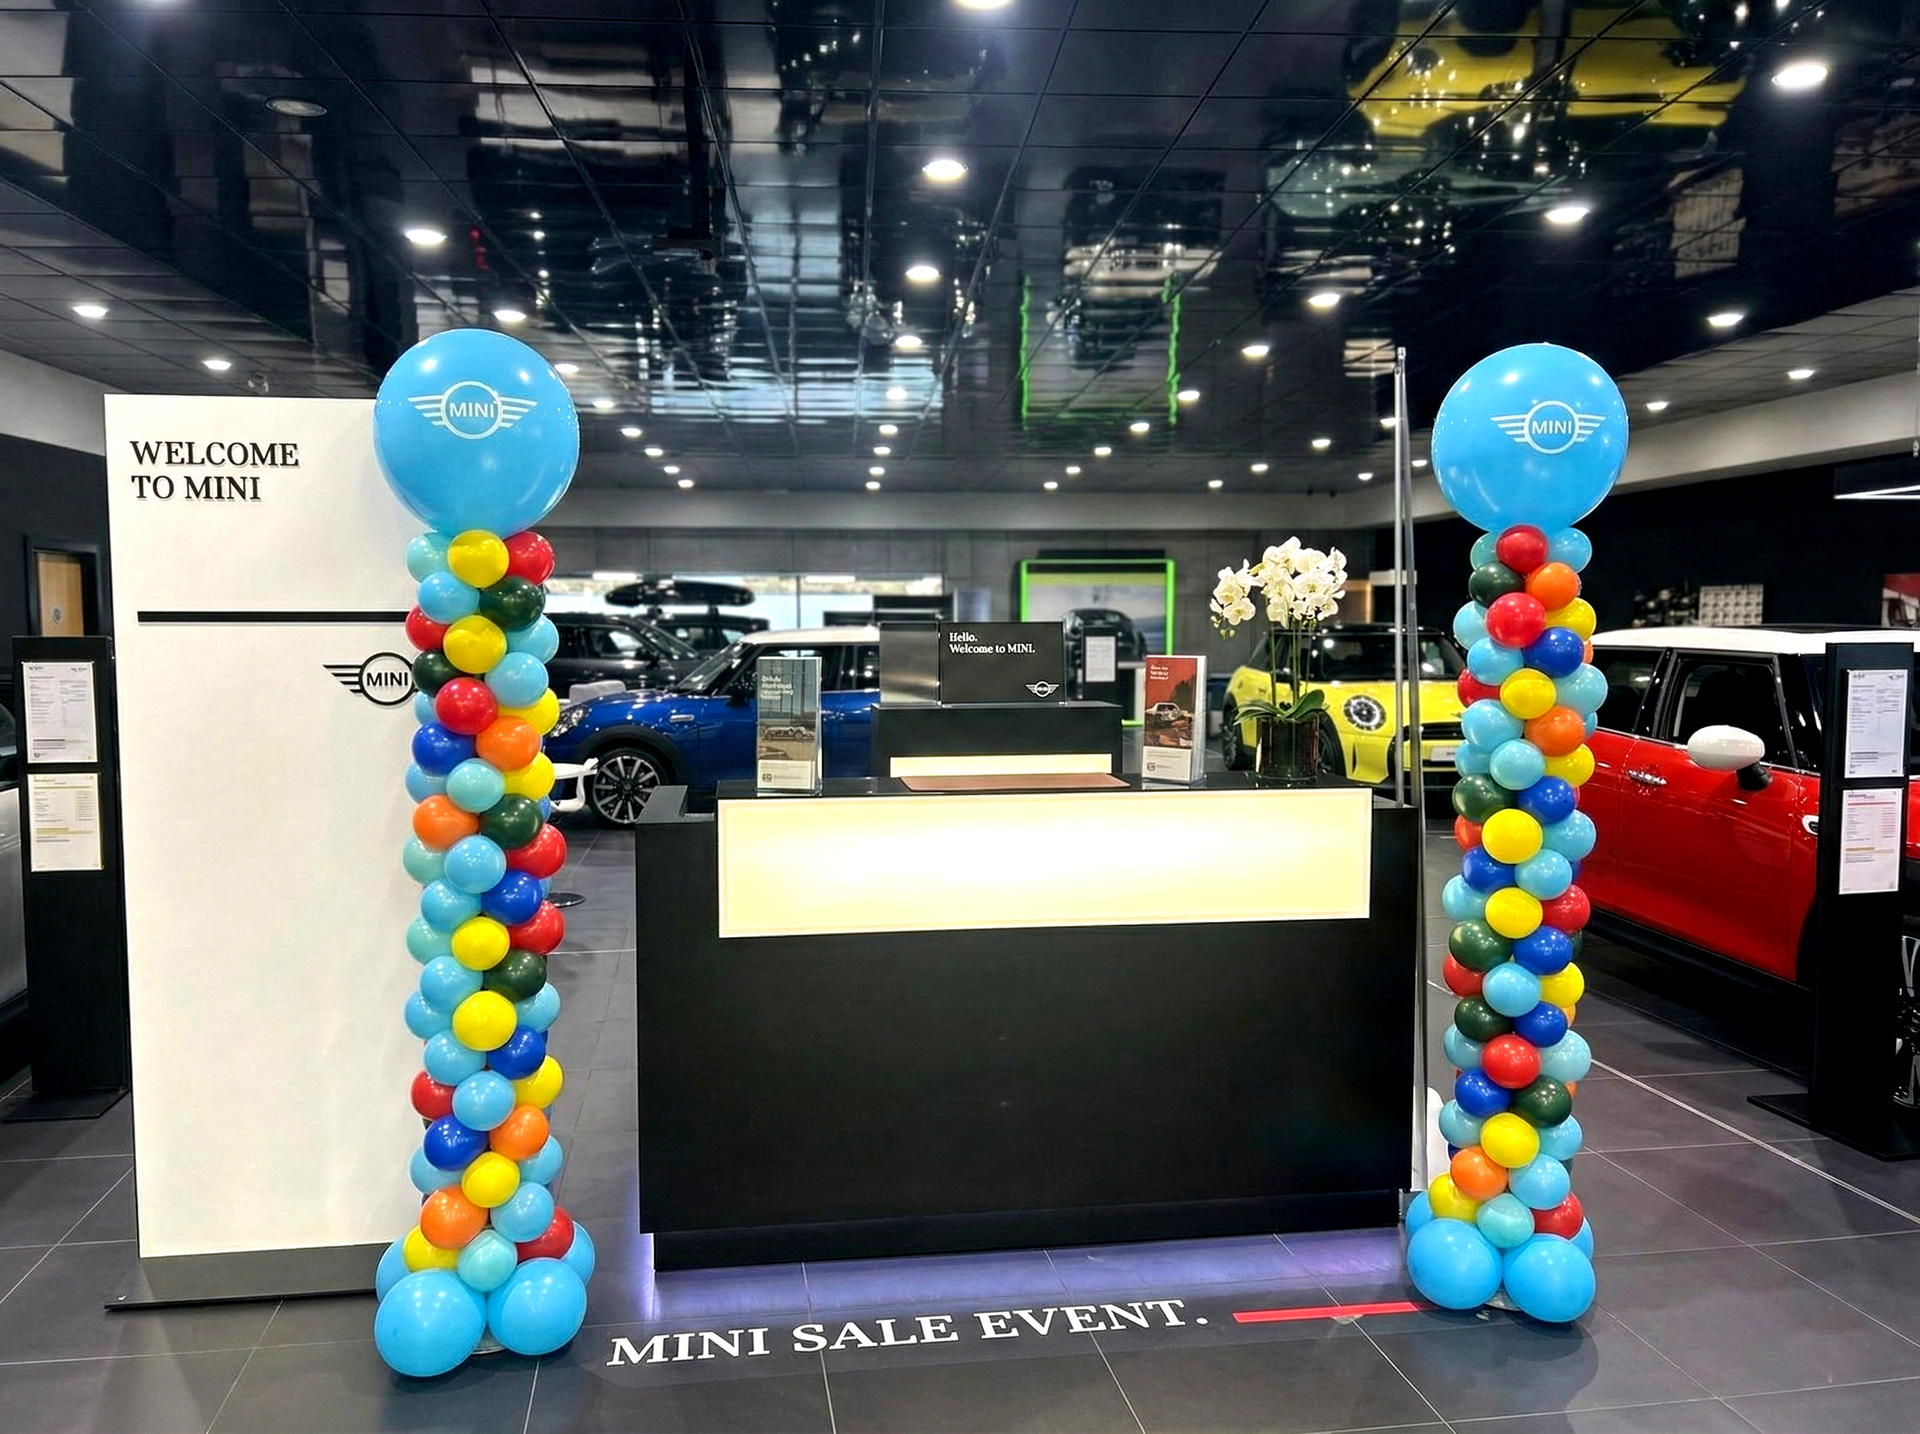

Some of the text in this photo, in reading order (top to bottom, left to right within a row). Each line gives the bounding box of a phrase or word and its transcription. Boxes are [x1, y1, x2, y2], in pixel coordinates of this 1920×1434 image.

[449, 402, 495, 418] MINI
[1532, 420, 1572, 435] MINI
[129, 440, 300, 467] WELCOME
[131, 475, 261, 500] TO MINI
[949, 632, 978, 642] Hello.
[949, 643, 1036, 653] Welcome to MINI.
[366, 672, 408, 686] MINI
[606, 1299, 1209, 1366] MINI SALE EVENT.
